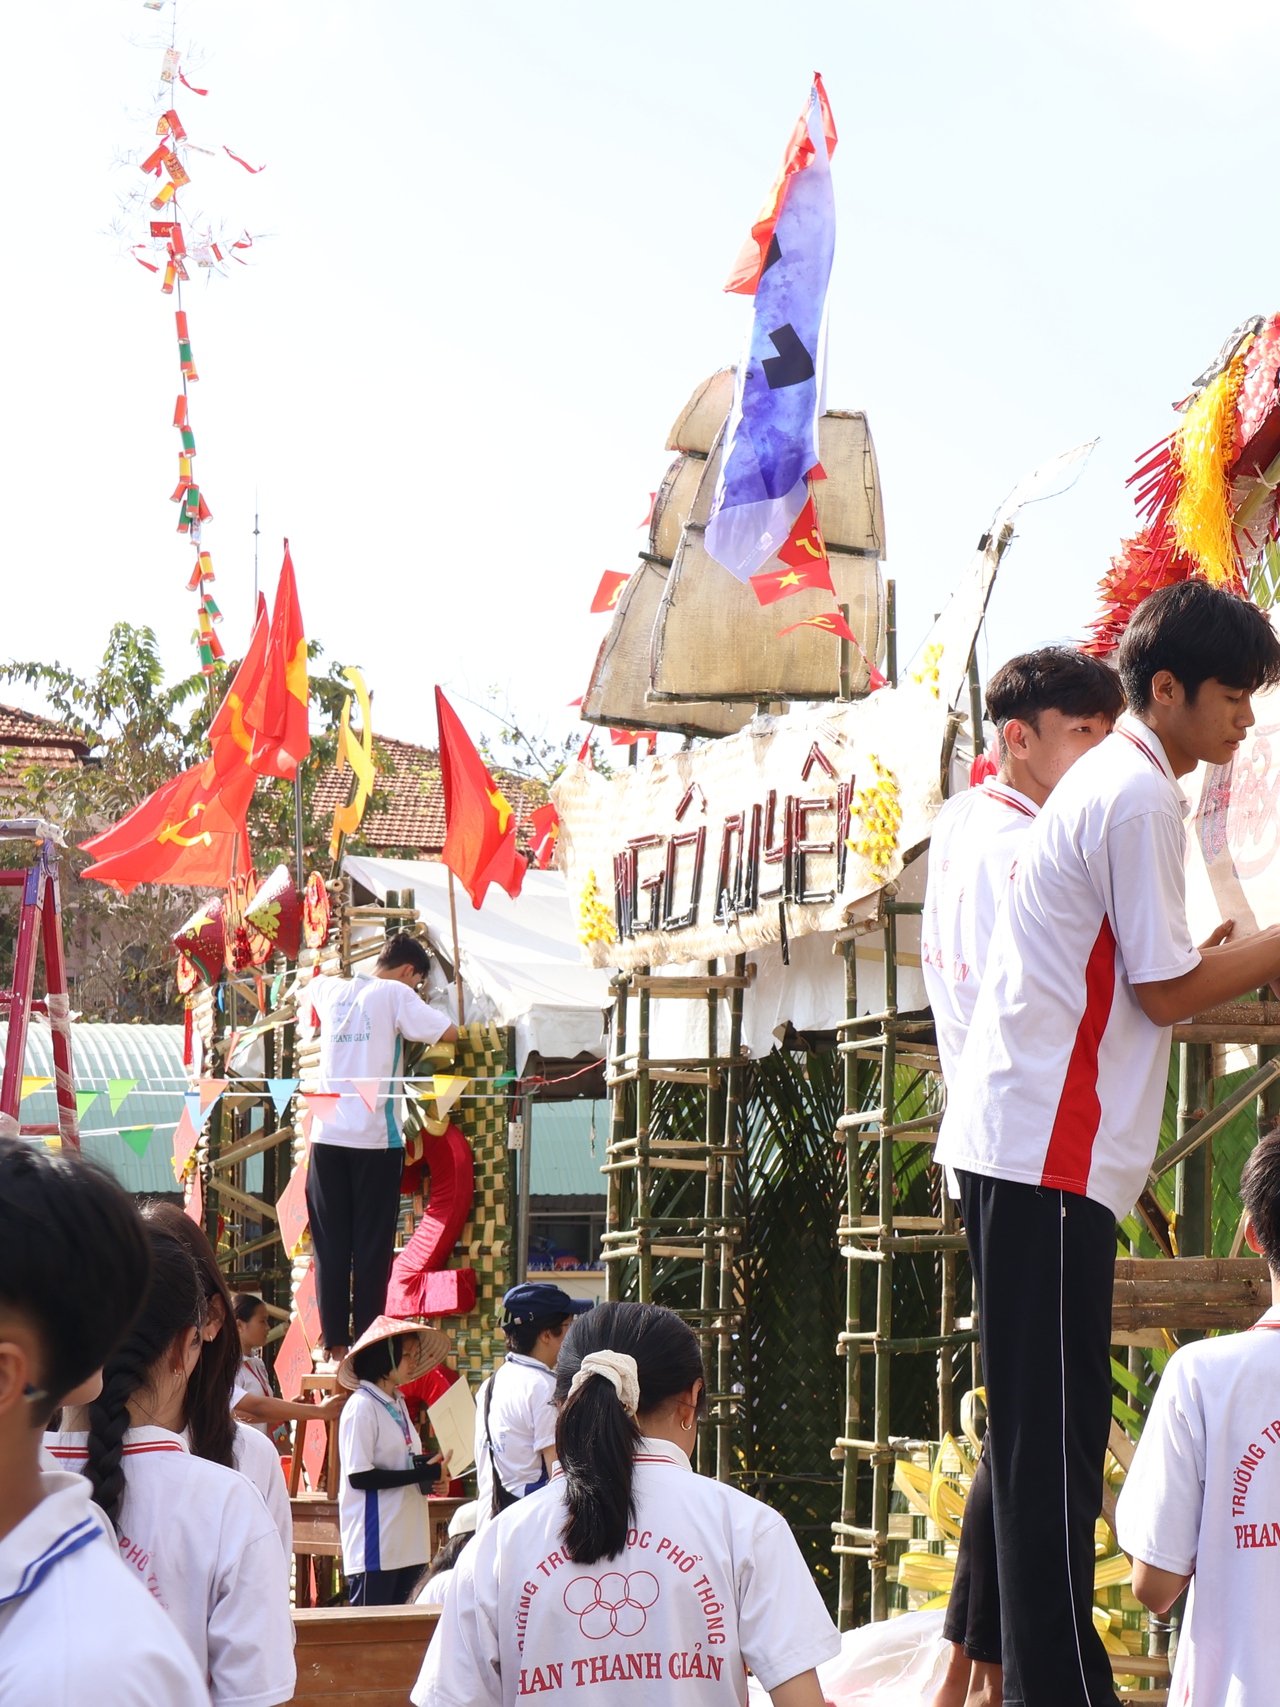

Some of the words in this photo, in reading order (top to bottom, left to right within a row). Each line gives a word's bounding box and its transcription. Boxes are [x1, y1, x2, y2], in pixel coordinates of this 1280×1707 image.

[1232, 1443, 1266, 1517] TRƯỜNG
[514, 1580, 539, 1658] RƯỜNG
[536, 1545, 575, 1577] TRU
[626, 1528, 653, 1550] ỌC
[656, 1537, 704, 1574] PHỔ
[693, 1574, 726, 1645] THÔNG
[516, 1663, 564, 1695] HAN
[571, 1652, 662, 1687] THANH
[668, 1642, 724, 1681] GIẢN
